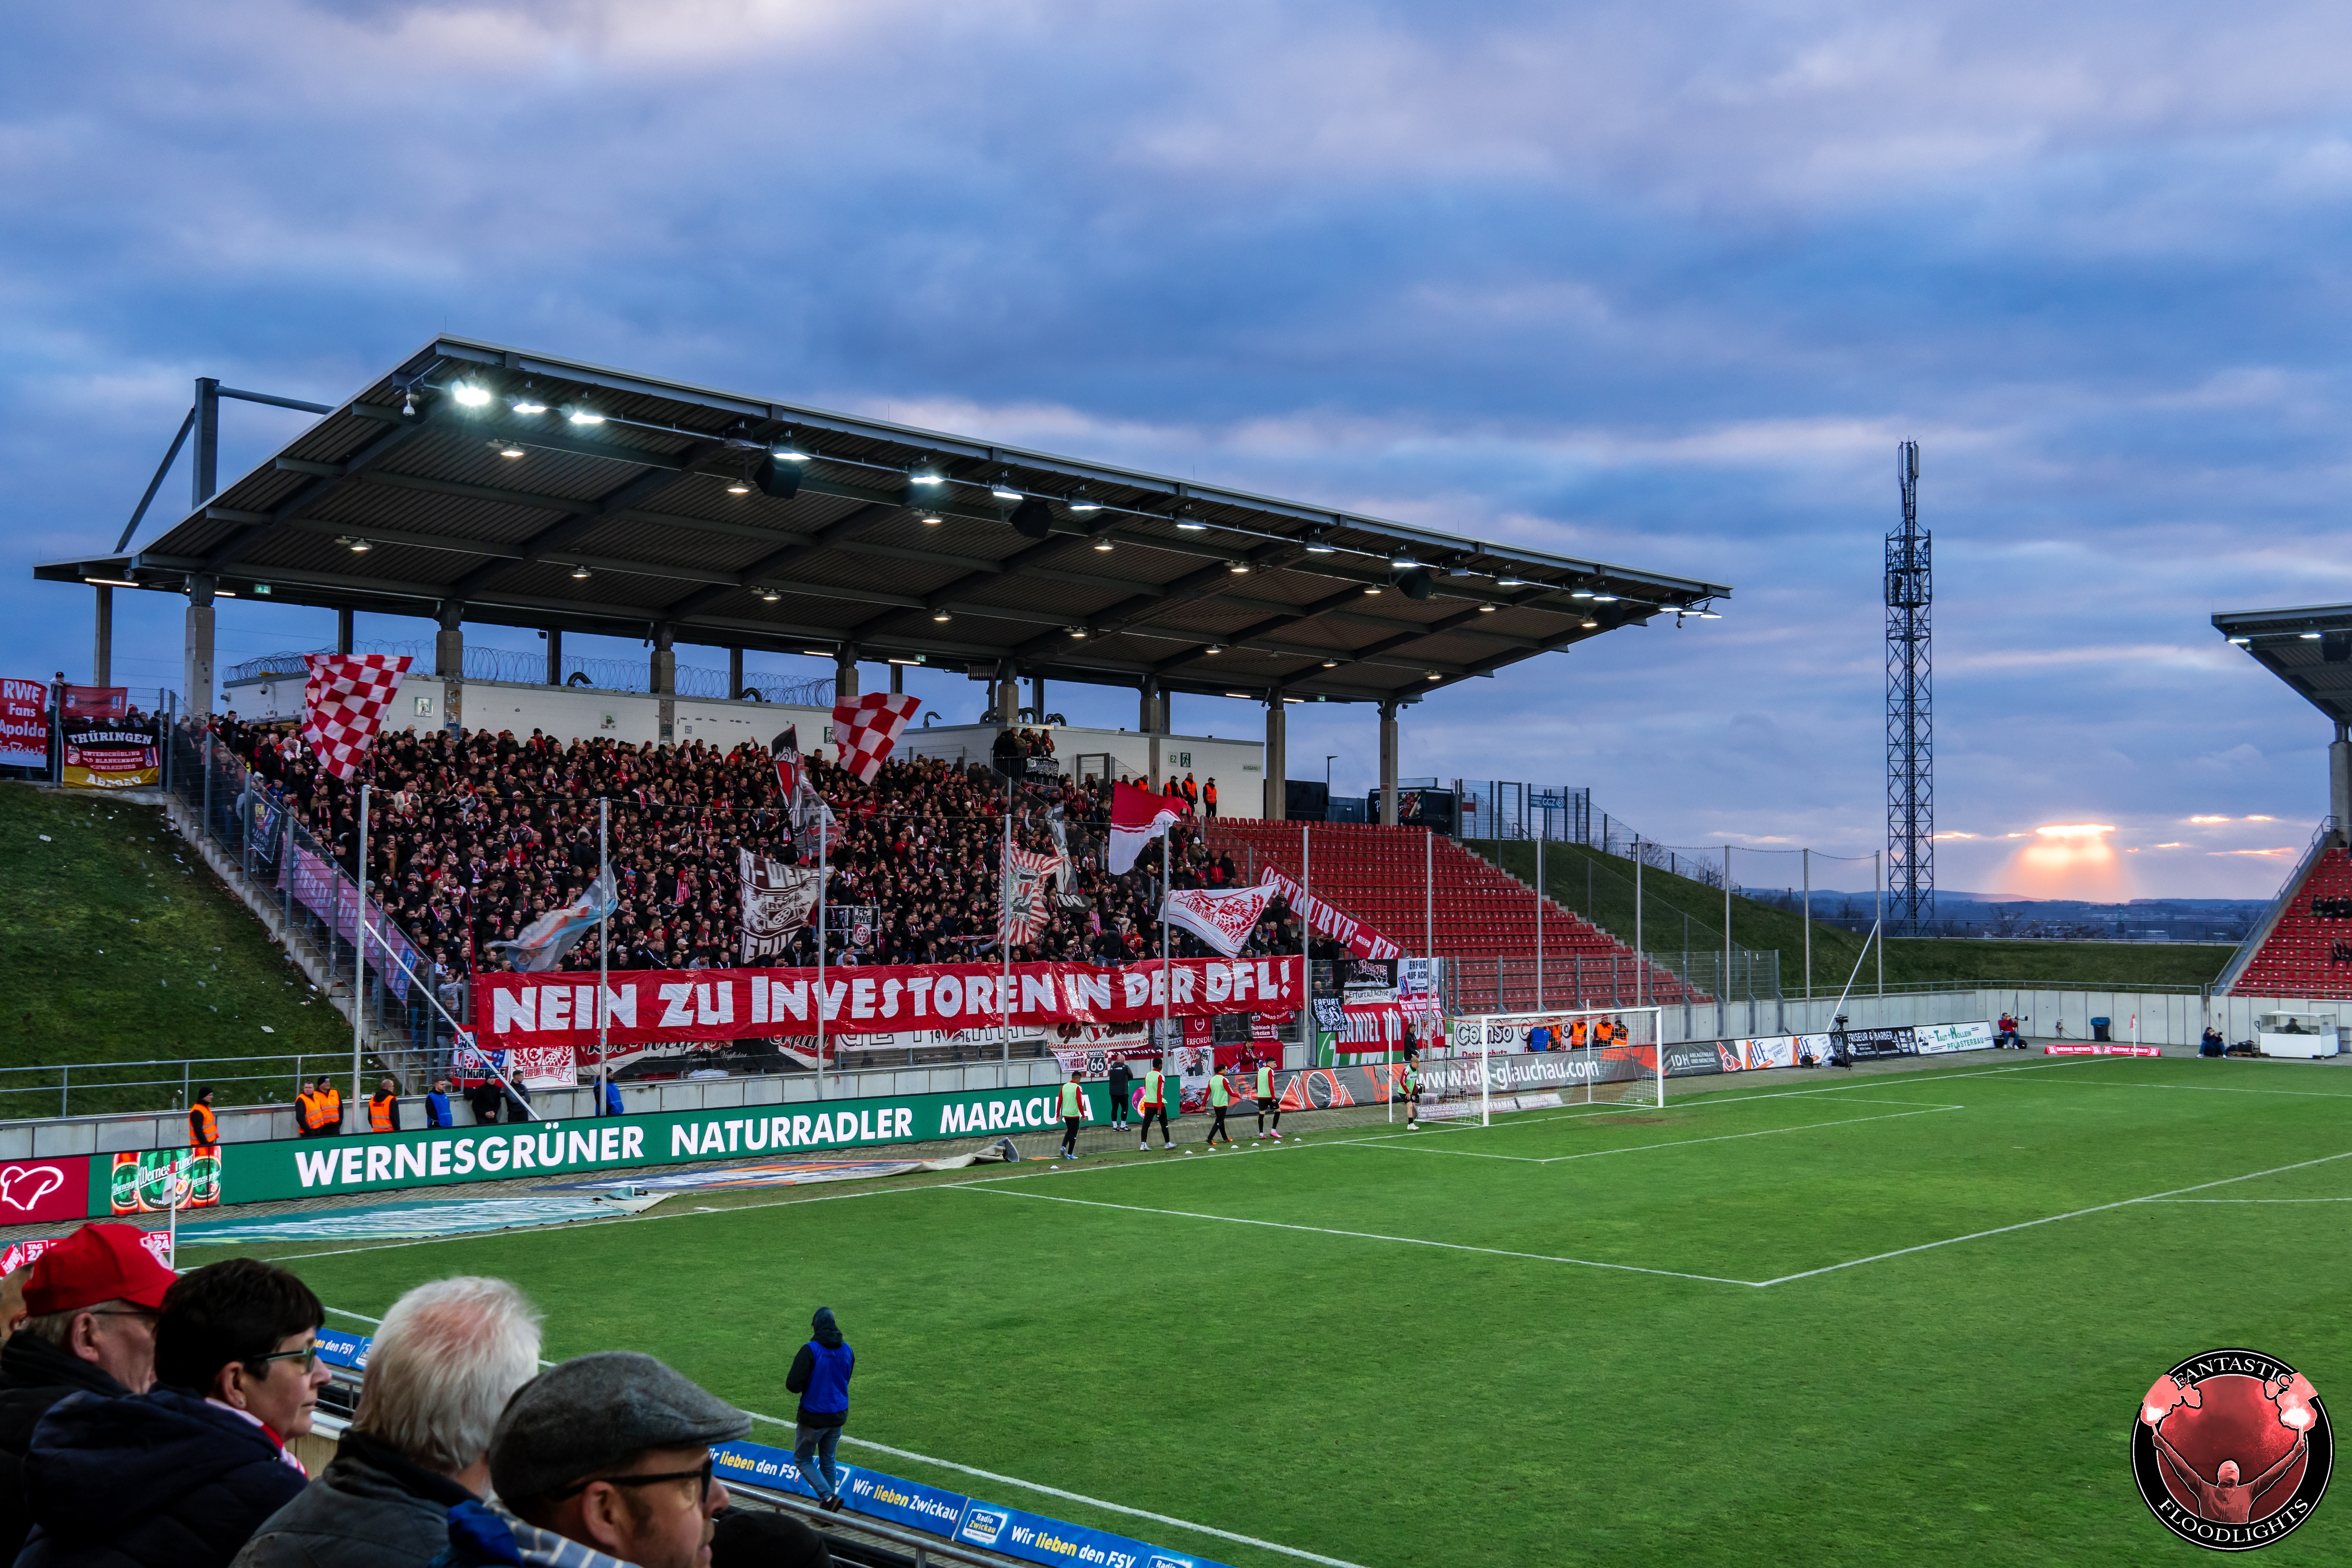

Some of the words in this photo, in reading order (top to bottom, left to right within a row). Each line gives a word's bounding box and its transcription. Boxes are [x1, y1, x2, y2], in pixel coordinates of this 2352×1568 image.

[4, 680, 42, 704] RWE
[9, 703, 36, 717] Fans
[0, 719, 46, 738] Apolda
[68, 730, 153, 744] THÜRINGEN
[1224, 903, 1249, 915] RWE
[1358, 936, 1368, 946] 1982
[494, 984, 637, 1034] NEIN
[658, 981, 734, 1027] ZU
[751, 974, 1056, 1024] INVESTOREN
[1065, 974, 1111, 1010] IN
[1123, 968, 1196, 1008] DER
[1206, 960, 1291, 1002] DFL!
[1382, 1011, 1402, 1041] ON
[931, 1030, 940, 1044] 19
[1187, 1036, 1213, 1045] ERFORDIA
[1847, 1032, 1868, 1042] FRISEUR
[1874, 1031, 1894, 1041] BARBER
[1947, 1037, 1984, 1050] PFLASTERBAU
[1746, 1040, 1769, 1069] HTE
[1773, 1047, 1785, 1057] EINERT
[1091, 1058, 1104, 1071] 66
[1671, 1054, 1690, 1066] IDH
[1416, 1058, 1600, 1090] www.idh-glauchau.com
[1417, 1104, 1452, 1113] ÖKOLOGISCHE
[295, 1122, 644, 1188] WERNESGRÜNER
[671, 1107, 913, 1156] NATURRADLER
[940, 1094, 1094, 1134] MARACUA
[155, 1240, 170, 1250] 24
[325, 1340, 339, 1352] den
[339, 1342, 356, 1355] FSV
[719, 1451, 755, 1470] lieben
[755, 1459, 778, 1475] den
[852, 1478, 874, 1497] Wir
[873, 1484, 909, 1507] lieben
[909, 1494, 958, 1522] Zwickau
[976, 1513, 993, 1524] Radio
[969, 1520, 996, 1534] Zwickau
[1011, 1525, 1035, 1545] Wir
[1035, 1531, 1077, 1557] lieben
[1078, 1544, 1105, 1565] den
[1106, 1551, 1137, 1568] FSV
